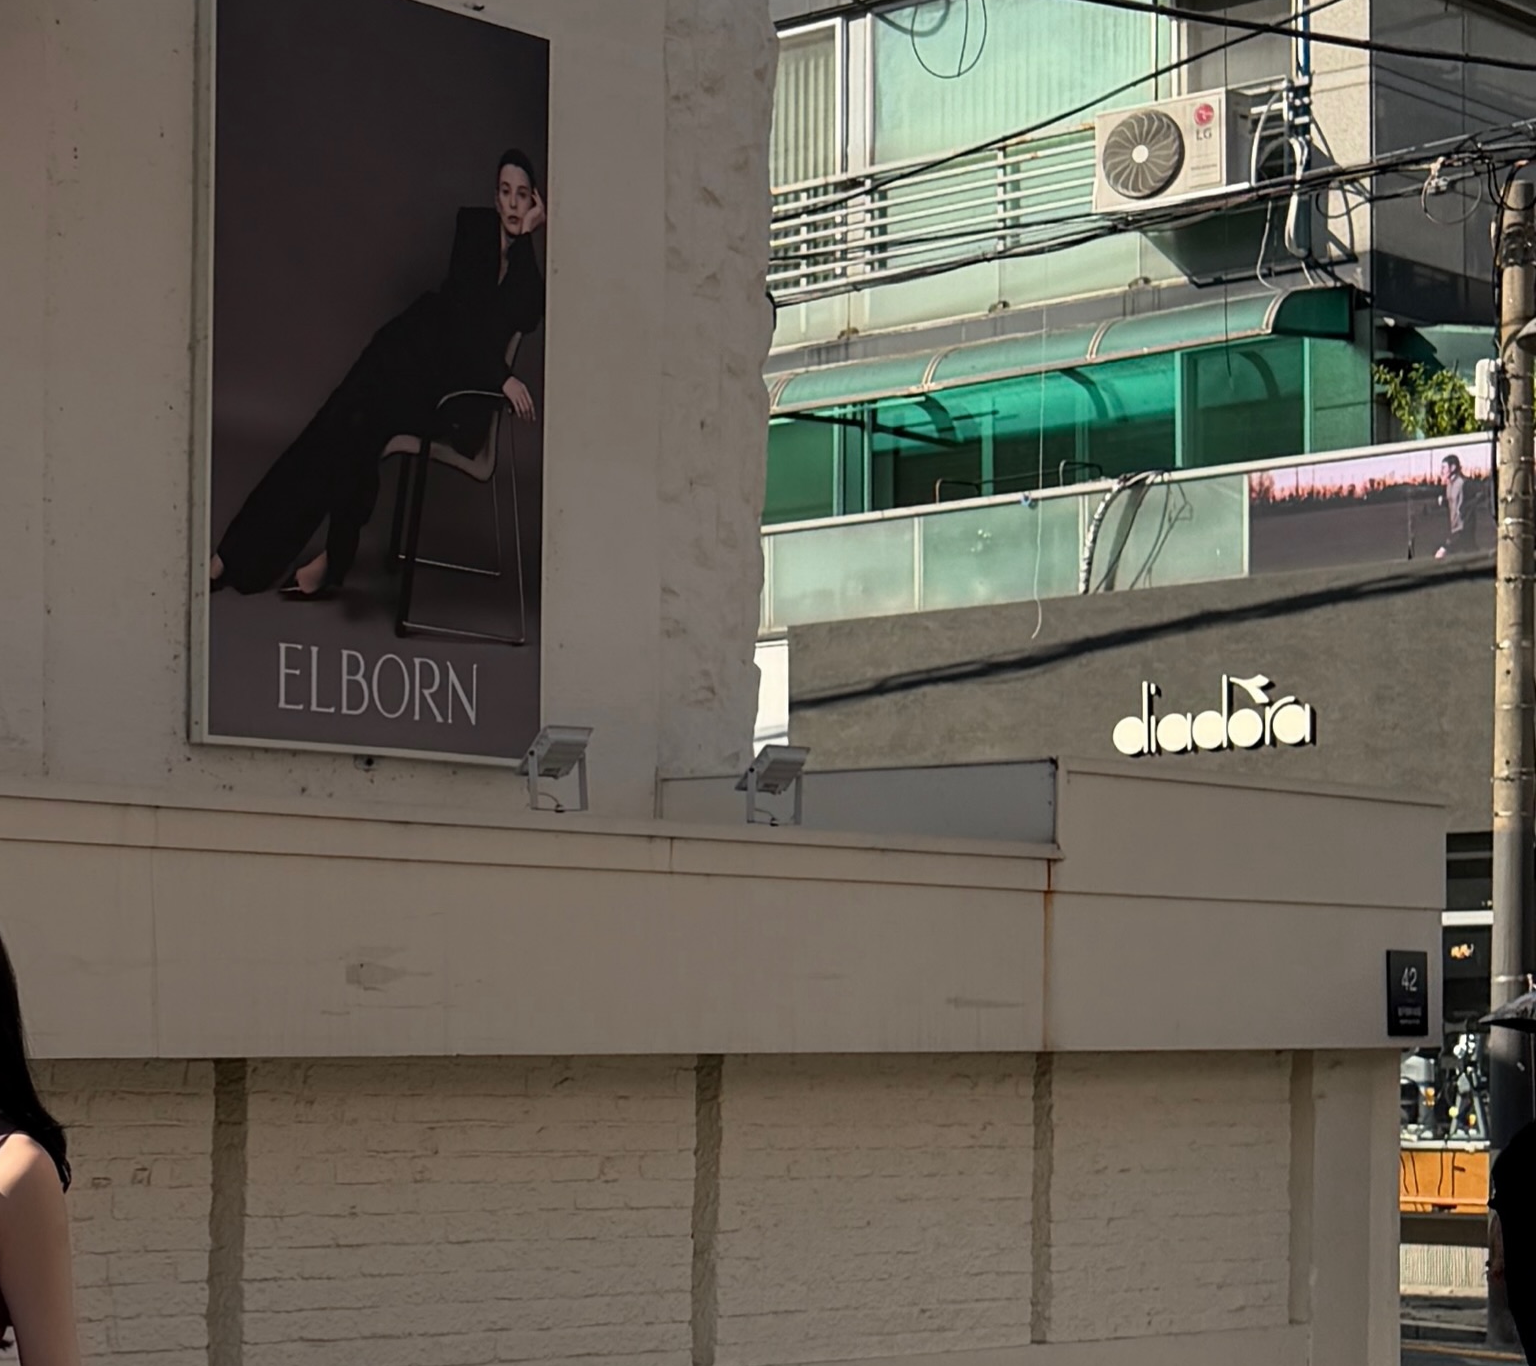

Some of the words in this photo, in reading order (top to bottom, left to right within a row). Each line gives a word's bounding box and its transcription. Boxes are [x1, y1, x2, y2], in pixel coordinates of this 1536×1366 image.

[1196, 128, 1212, 141] LG
[278, 643, 477, 726] ELBORN
[1113, 674, 1311, 755] diadora
[1401, 967, 1418, 991] 42
